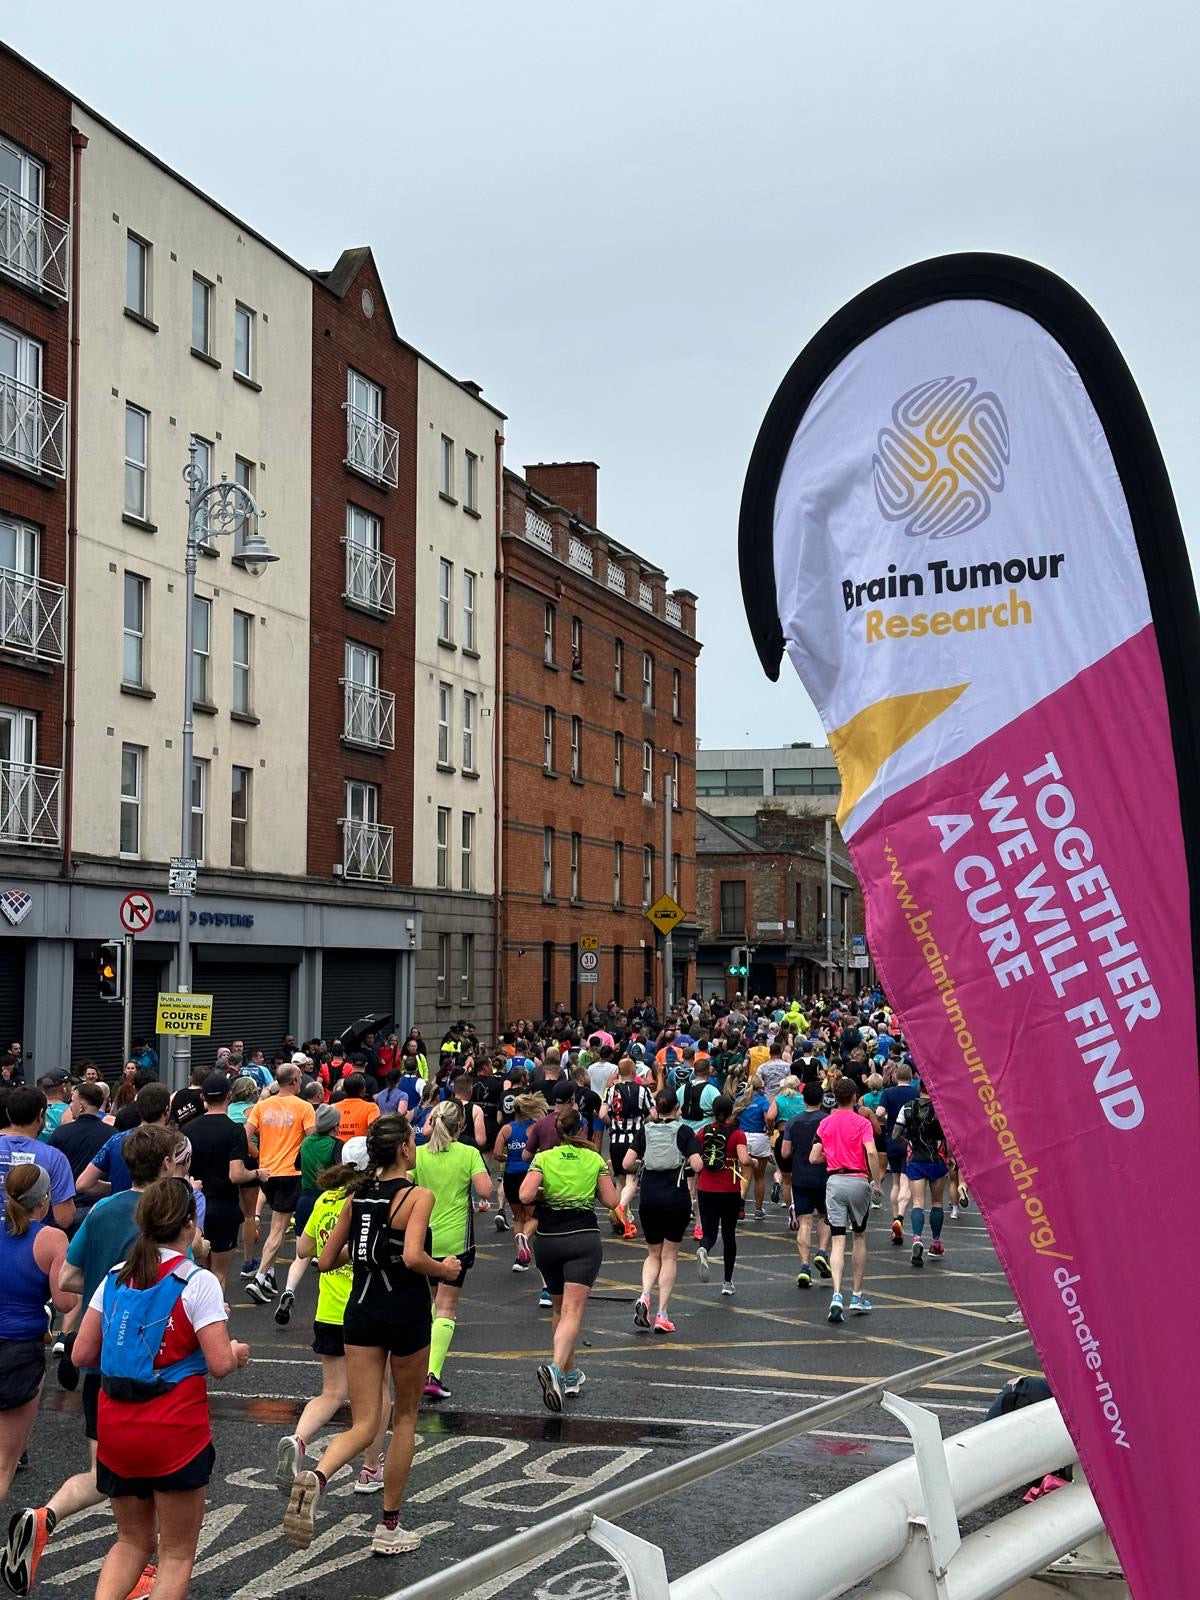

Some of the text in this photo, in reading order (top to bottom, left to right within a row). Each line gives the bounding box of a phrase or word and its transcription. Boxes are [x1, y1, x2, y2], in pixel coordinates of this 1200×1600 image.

[842, 553, 1065, 612] Brain Tumour
[866, 588, 1032, 643] Research
[927, 813, 1034, 989] A CURE
[1023, 752, 1161, 1032] TOGETHER
[198, 911, 254, 928] SYSTEMS
[979, 772, 1145, 1131] WE WILL FIND
[161, 1011, 208, 1021] COURSE
[164, 1021, 203, 1030] ROUTE
[357, 1213, 371, 1262] UTOBEST
[116, 1309, 131, 1346] EVADICT
